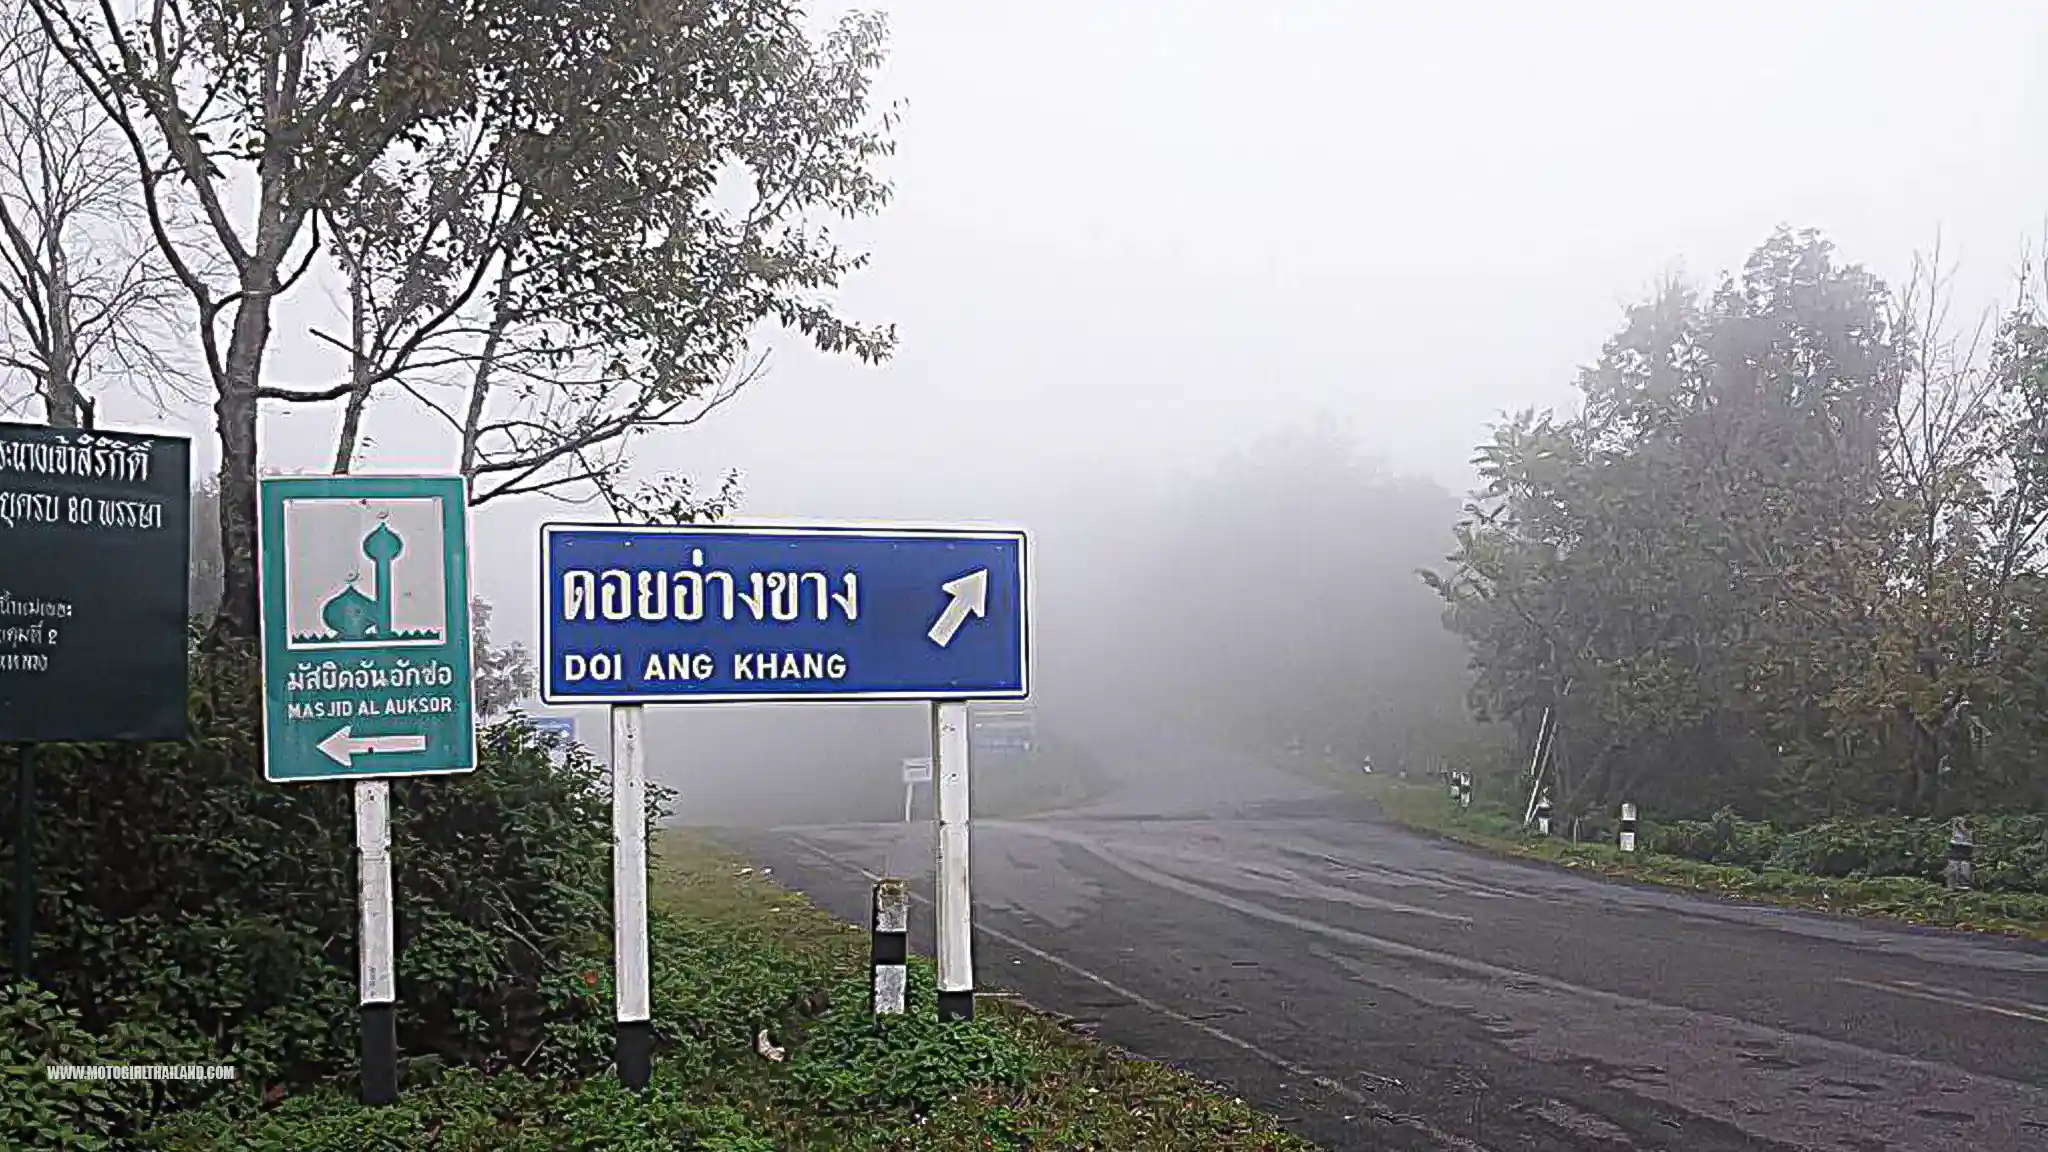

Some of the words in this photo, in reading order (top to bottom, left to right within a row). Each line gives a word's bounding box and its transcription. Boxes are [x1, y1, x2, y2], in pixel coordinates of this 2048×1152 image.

[68, 495, 93, 525] 80
[98, 499, 162, 529] พรรษา
[562, 548, 859, 622] ดอยอ่างขาง
[564, 652, 623, 682] DOI
[643, 652, 714, 682] ANG
[734, 652, 848, 681] KHANG
[287, 700, 353, 720] MASJID
[358, 699, 381, 717] AL
[385, 696, 453, 715] AUKSOR
